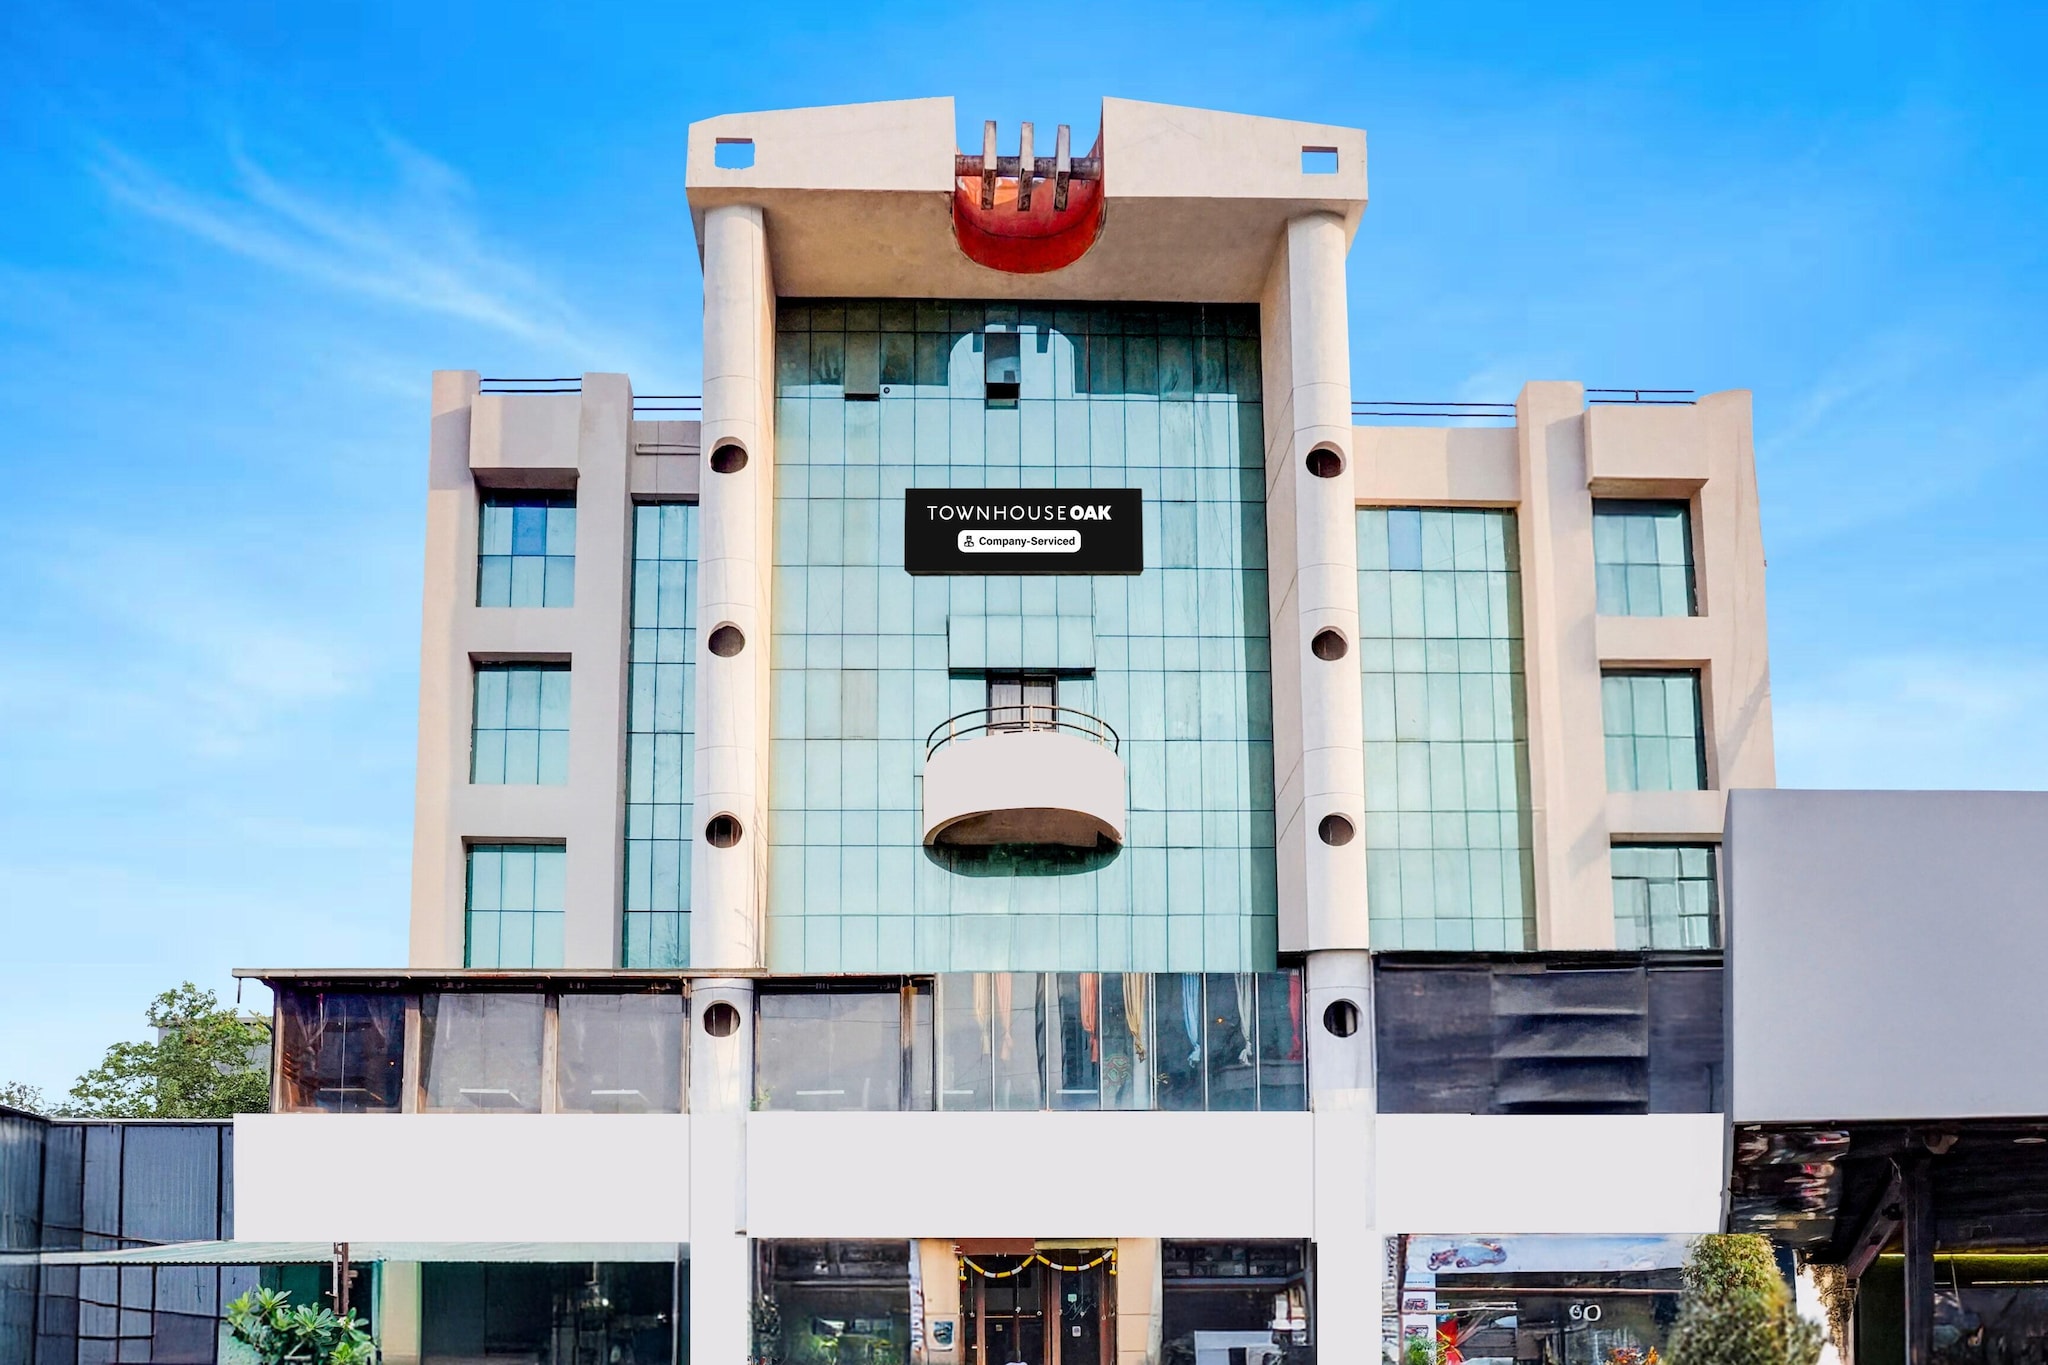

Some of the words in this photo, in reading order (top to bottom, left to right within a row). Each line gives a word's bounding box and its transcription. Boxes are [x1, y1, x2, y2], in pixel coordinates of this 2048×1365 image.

[926, 505, 1067, 521] TOWNHOUSE
[1069, 504, 1113, 521] OAK
[978, 536, 1076, 548] Company-Serviced
